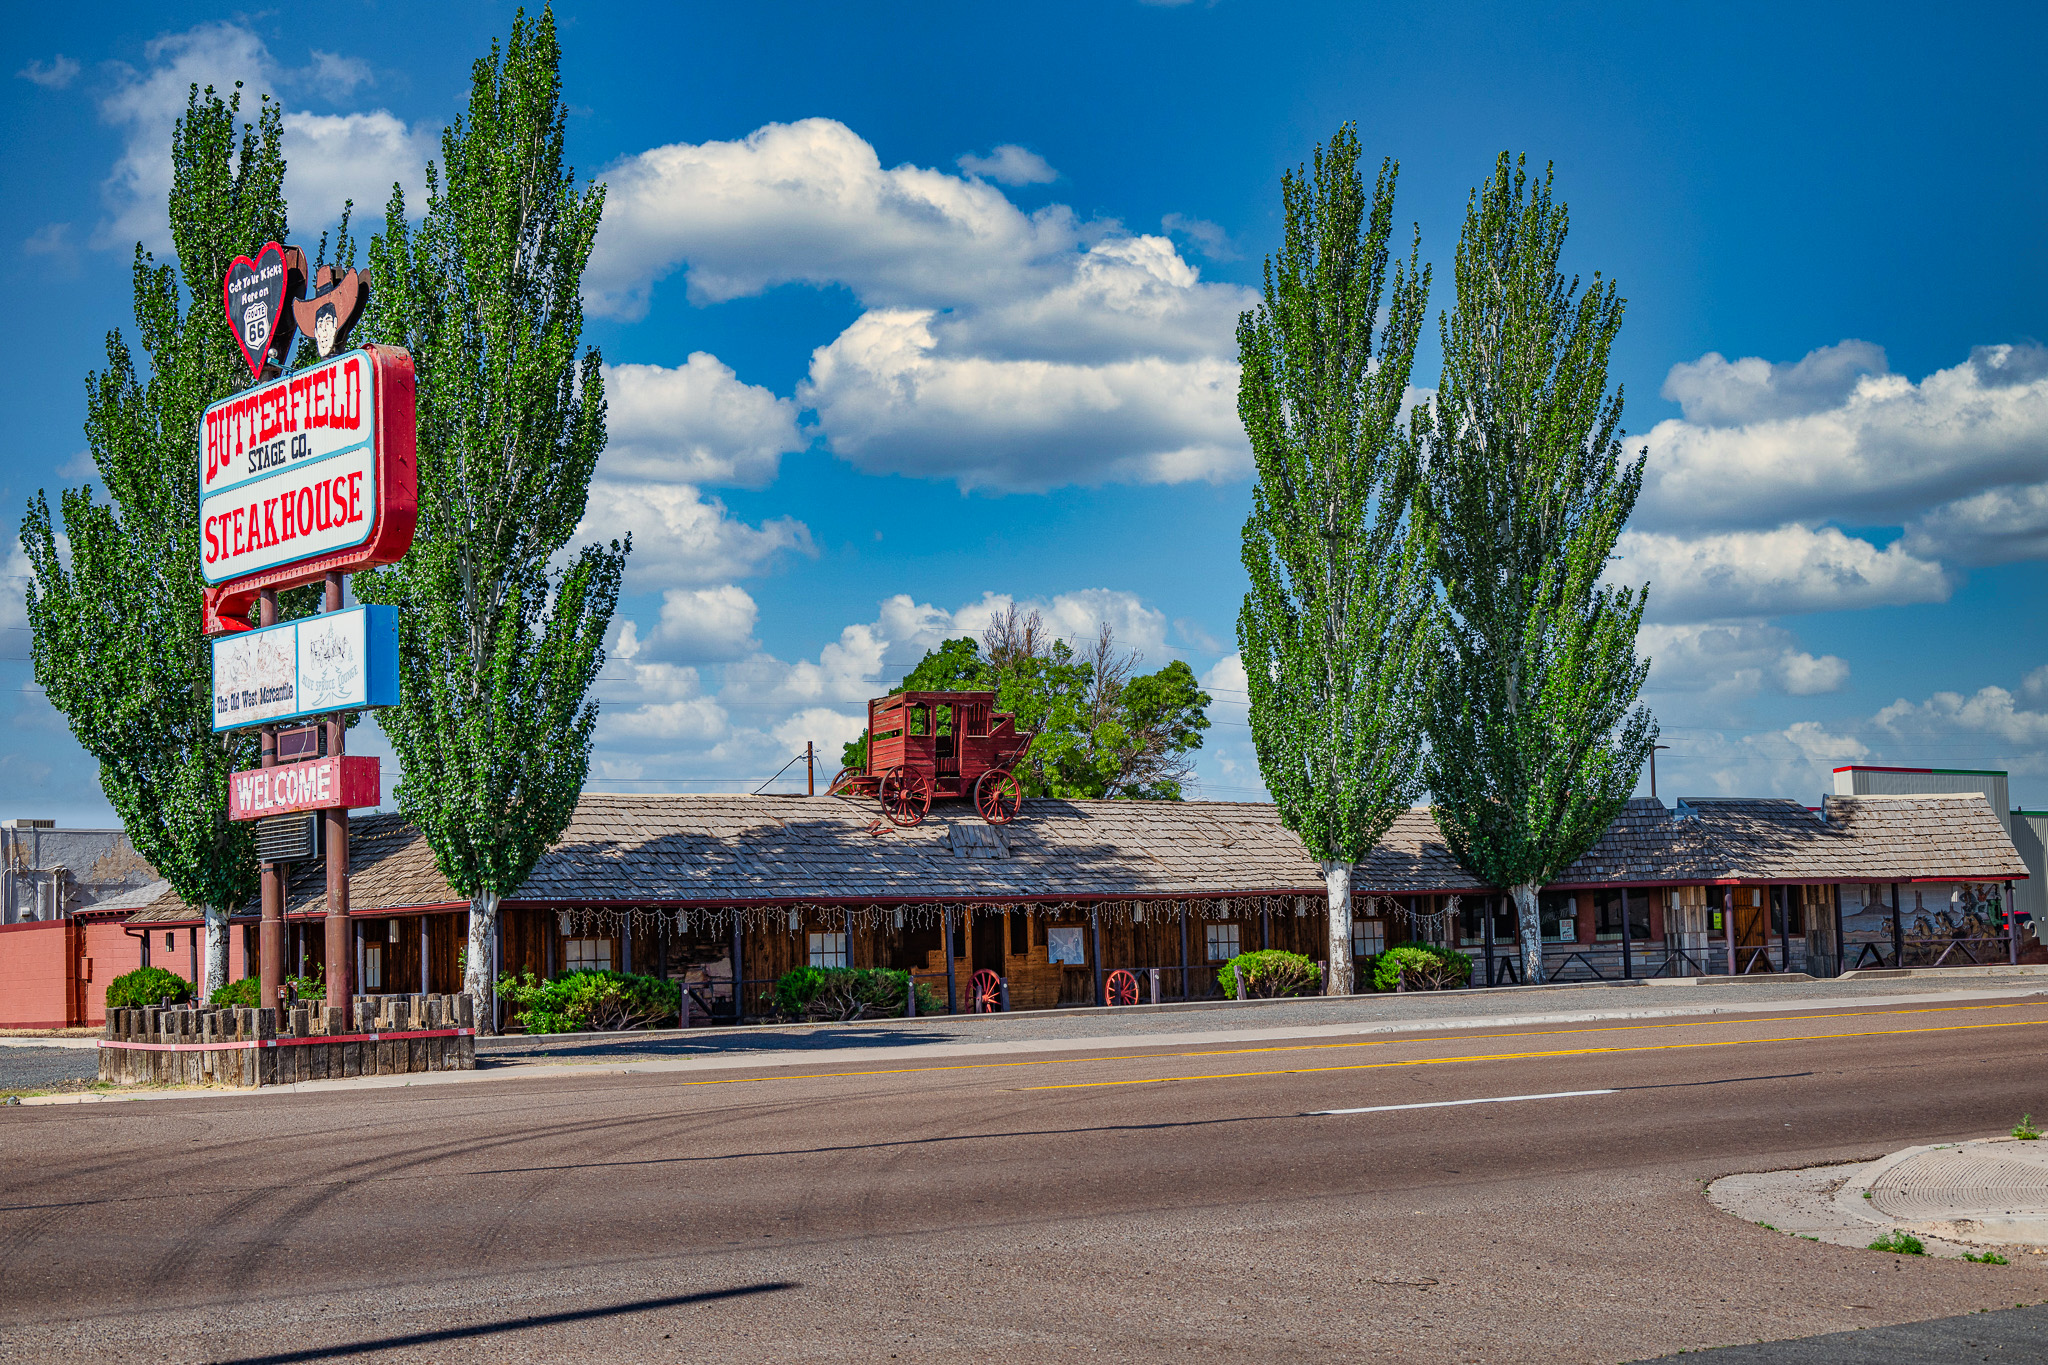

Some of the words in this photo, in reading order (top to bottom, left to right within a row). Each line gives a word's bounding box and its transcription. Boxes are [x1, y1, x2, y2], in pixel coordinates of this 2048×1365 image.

[228, 279, 242, 294] Get
[242, 276, 250, 288] To
[242, 292, 258, 305] Here
[260, 287, 269, 298] on
[248, 306, 264, 319] ROUTE
[250, 320, 265, 342] 66
[206, 358, 362, 484] BUTTERFIELD
[248, 440, 286, 474] STAGE
[291, 433, 312, 460] CO.
[205, 470, 362, 564] STEAKHOUSE
[302, 674, 314, 690] BLUE
[316, 678, 335, 691] SPRUCE
[338, 664, 358, 687] LOUNGE
[217, 696, 228, 714] The
[230, 692, 240, 711] Old
[242, 689, 258, 708] West
[260, 682, 294, 705] Mercantile
[236, 764, 331, 810] WELCOME
